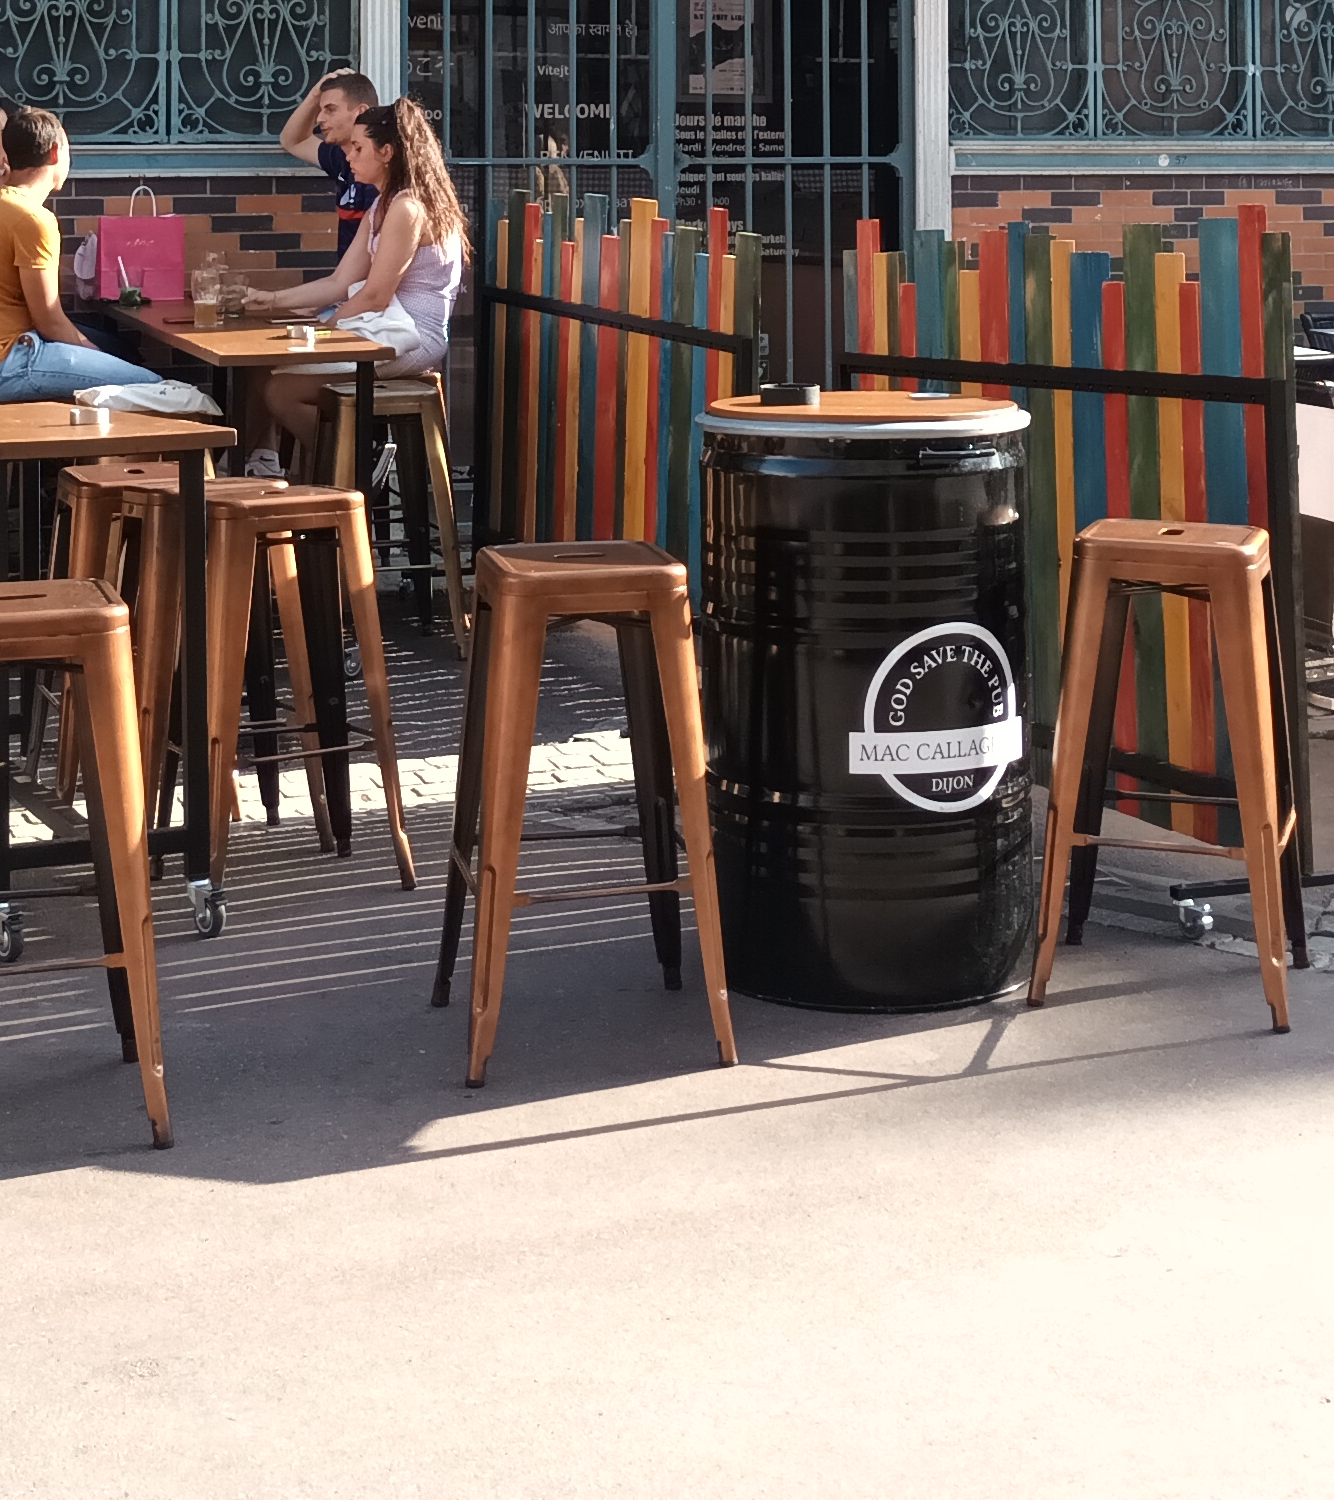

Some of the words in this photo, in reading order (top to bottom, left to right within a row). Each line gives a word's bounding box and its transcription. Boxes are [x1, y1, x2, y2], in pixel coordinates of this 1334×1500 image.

[888, 678, 913, 726] GOD
[910, 646, 957, 679] SAVE
[962, 646, 994, 678] THE
[988, 675, 1004, 717] PUB
[859, 744, 910, 762] MAC
[916, 736, 995, 761] CALLAG
[931, 774, 974, 793] DIJON
